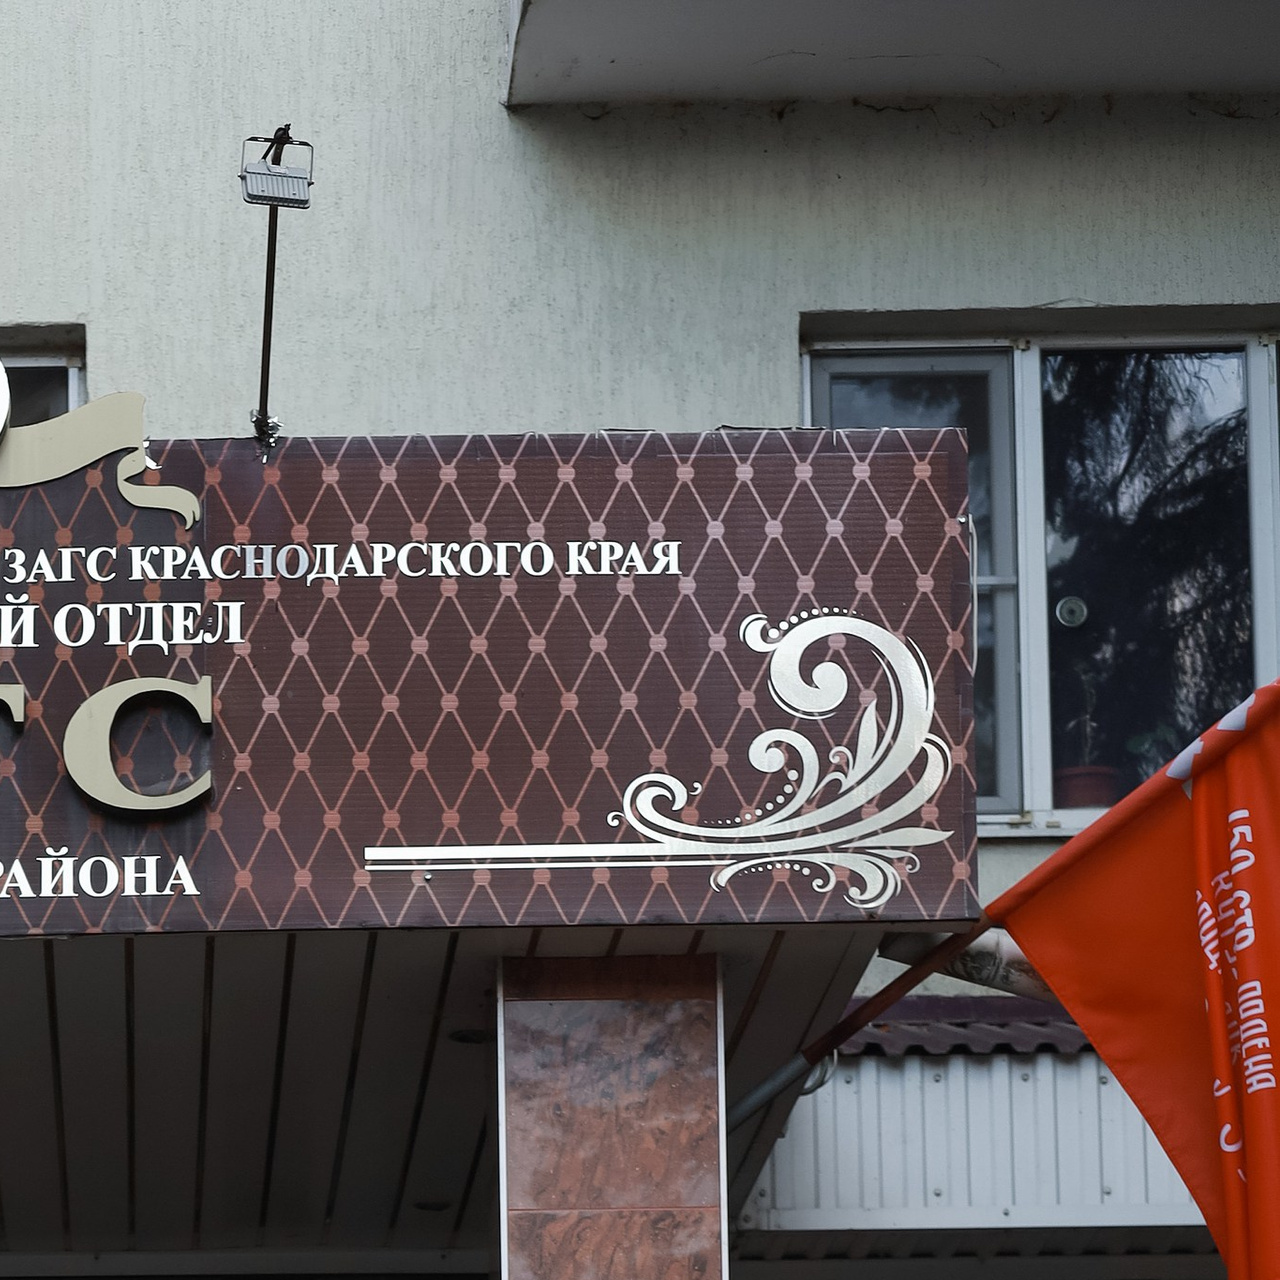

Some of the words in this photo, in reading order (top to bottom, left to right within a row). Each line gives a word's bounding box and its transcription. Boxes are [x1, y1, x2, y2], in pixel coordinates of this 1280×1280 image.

[3, 545, 118, 584] ЗАГС
[128, 541, 554, 587] КРАСНОДАРСКОГО
[565, 541, 682, 576] КРАЯ
[53, 601, 246, 656] ОТДЕЛ
